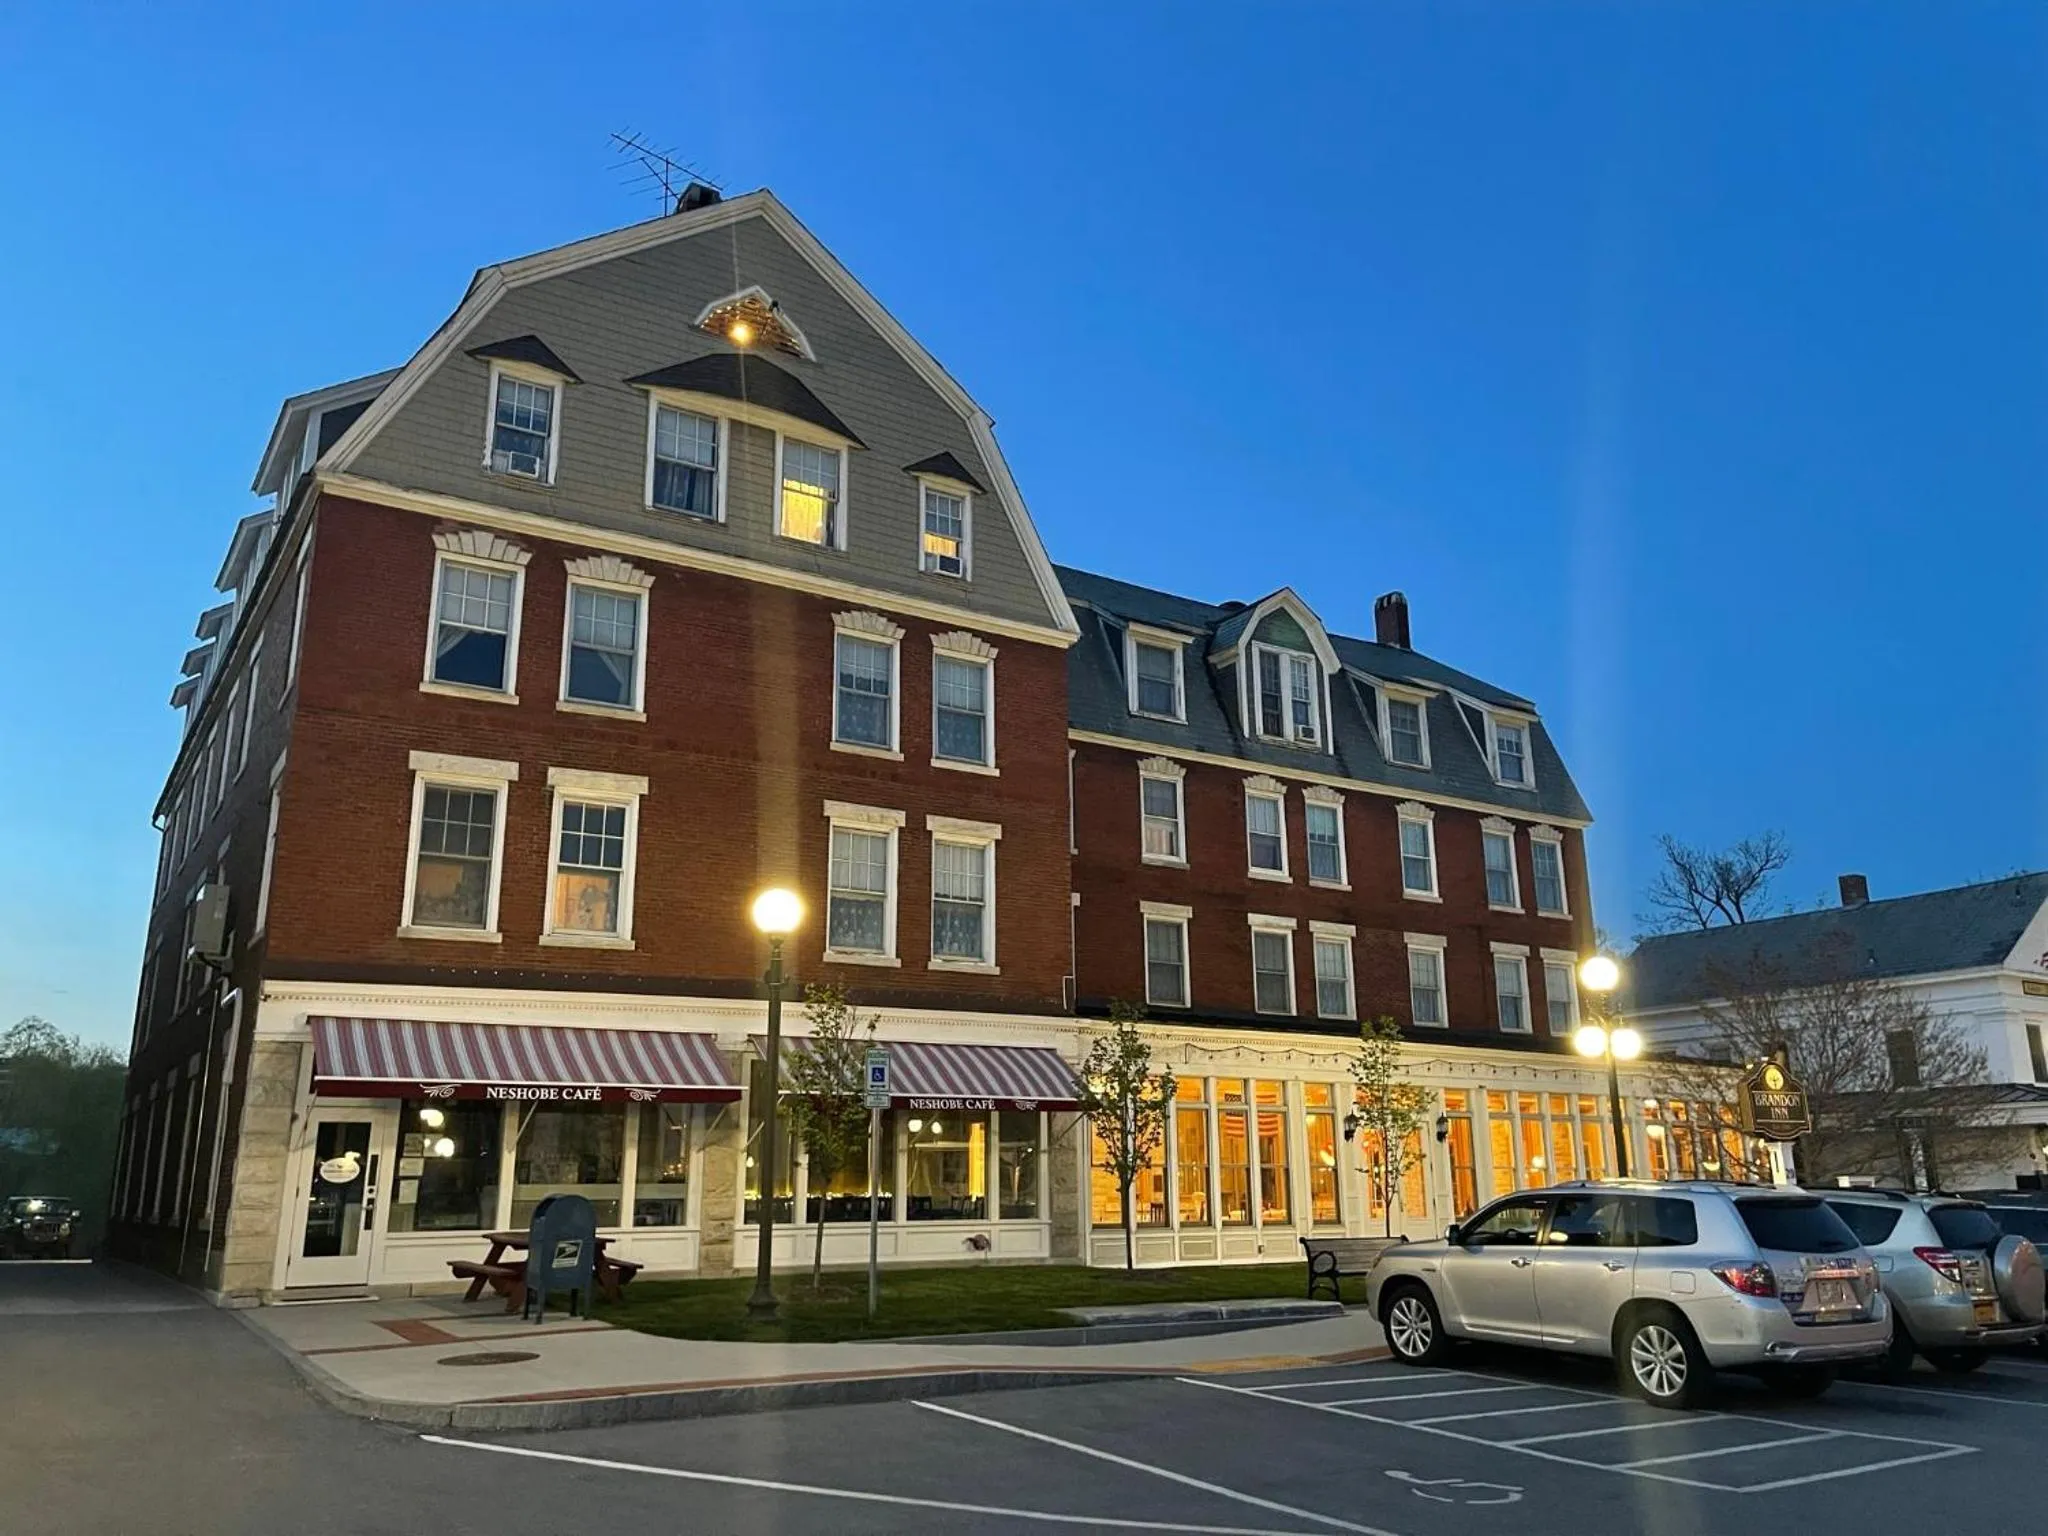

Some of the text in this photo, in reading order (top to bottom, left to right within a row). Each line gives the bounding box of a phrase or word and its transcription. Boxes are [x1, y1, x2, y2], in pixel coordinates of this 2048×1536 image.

[486, 1086, 602, 1100] NESHOBE CAFÉ
[910, 1098, 996, 1110] NESHOBE CAFÉ
[1755, 1094, 1799, 1106] BRANDON
[1771, 1107, 1788, 1118] INN
